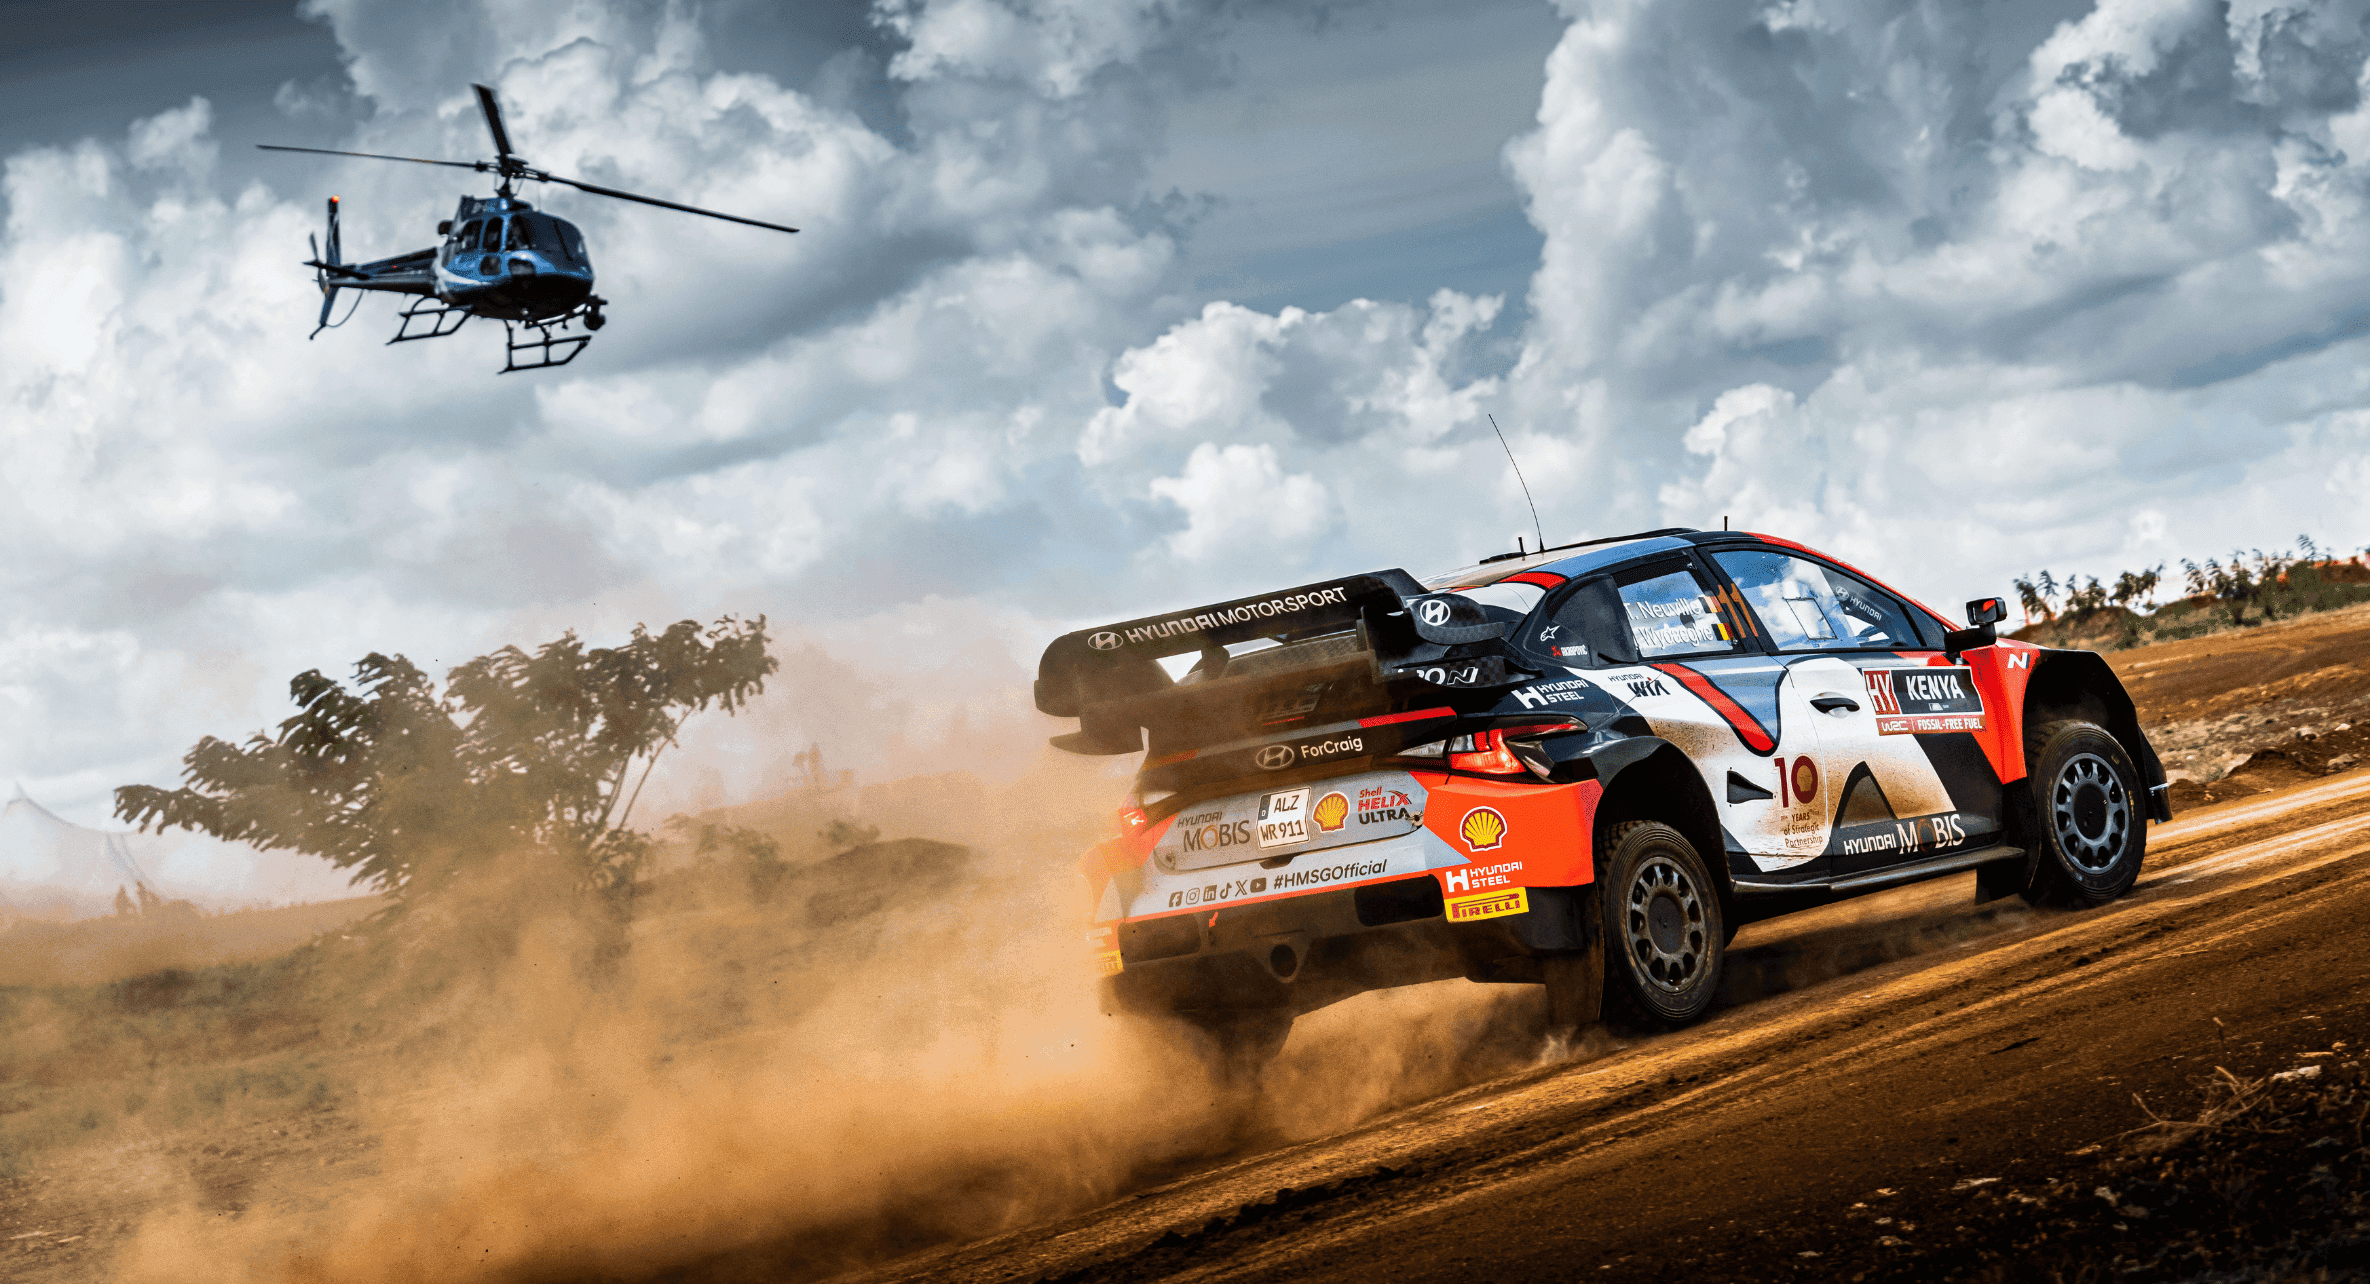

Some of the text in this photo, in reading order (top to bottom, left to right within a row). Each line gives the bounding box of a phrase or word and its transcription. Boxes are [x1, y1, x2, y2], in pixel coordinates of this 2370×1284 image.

[1125, 587, 1347, 643] HYUNDAI MOTORSPORT
[1636, 598, 1702, 619] Neuville
[1717, 583, 1759, 638] 11
[1849, 596, 1882, 620] HYUNDAI
[1637, 622, 1714, 650] Wydaeghe
[1536, 679, 1589, 694] HYUNDAI
[1608, 673, 1644, 682] HYUNDAI
[1546, 691, 1584, 704] STEEL
[1865, 674, 1965, 711] HY KENYA
[1881, 720, 1908, 732] WRC
[1917, 718, 1963, 731] FOSSIL-FREE
[1963, 717, 1983, 730] FUEL
[1300, 736, 1363, 758] ForCraig
[1360, 786, 1382, 798] Shell
[1774, 755, 1818, 808] 10
[1274, 794, 1300, 813] ALZ
[1358, 793, 1410, 811] HELIX
[1178, 811, 1222, 828] HYUNDAI
[1358, 807, 1411, 825] ULTRA
[1792, 812, 1810, 822] YEARS
[1183, 820, 1251, 853] MOBIS
[1260, 819, 1304, 841] WR 911
[1843, 814, 1965, 856] HYUNDAI MOBIS
[1273, 859, 1388, 889] #HMSGOfficial
[1470, 861, 1523, 877] HYUNDAI
[1471, 875, 1511, 888] STEEL
[1451, 893, 1520, 919] PIRELLI
